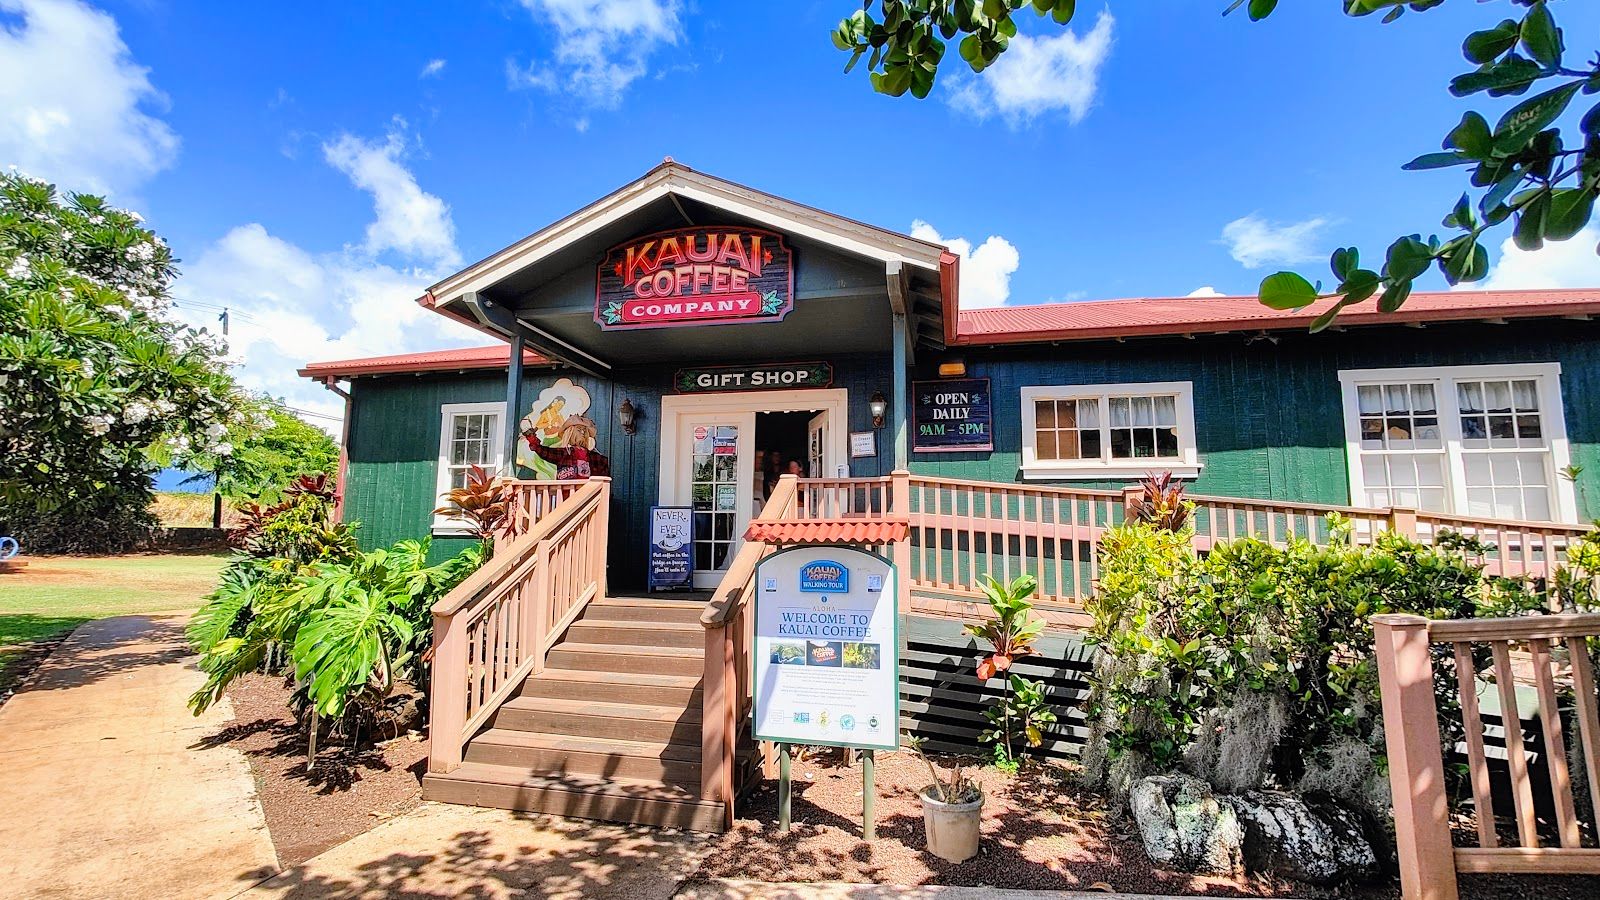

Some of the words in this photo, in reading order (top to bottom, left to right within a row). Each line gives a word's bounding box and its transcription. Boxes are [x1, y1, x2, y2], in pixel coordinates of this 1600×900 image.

[623, 233, 762, 288] KAUAI
[634, 263, 750, 298] COFFEE
[631, 299, 752, 317] COMPANY
[697, 373, 745, 388] GIFT
[750, 370, 809, 385] SHOP
[935, 392, 969, 405] OPEN
[933, 407, 971, 420] DAILY
[919, 423, 945, 436] 9AM
[958, 422, 984, 435] 5PM
[660, 524, 688, 537] EVER
[806, 566, 841, 578] KAUAI
[809, 573, 838, 581] COFFEE
[782, 612, 846, 624] WELCOME
[850, 614, 868, 626] TO
[778, 624, 819, 636] KAUAI
[822, 625, 872, 638] COFFEE
